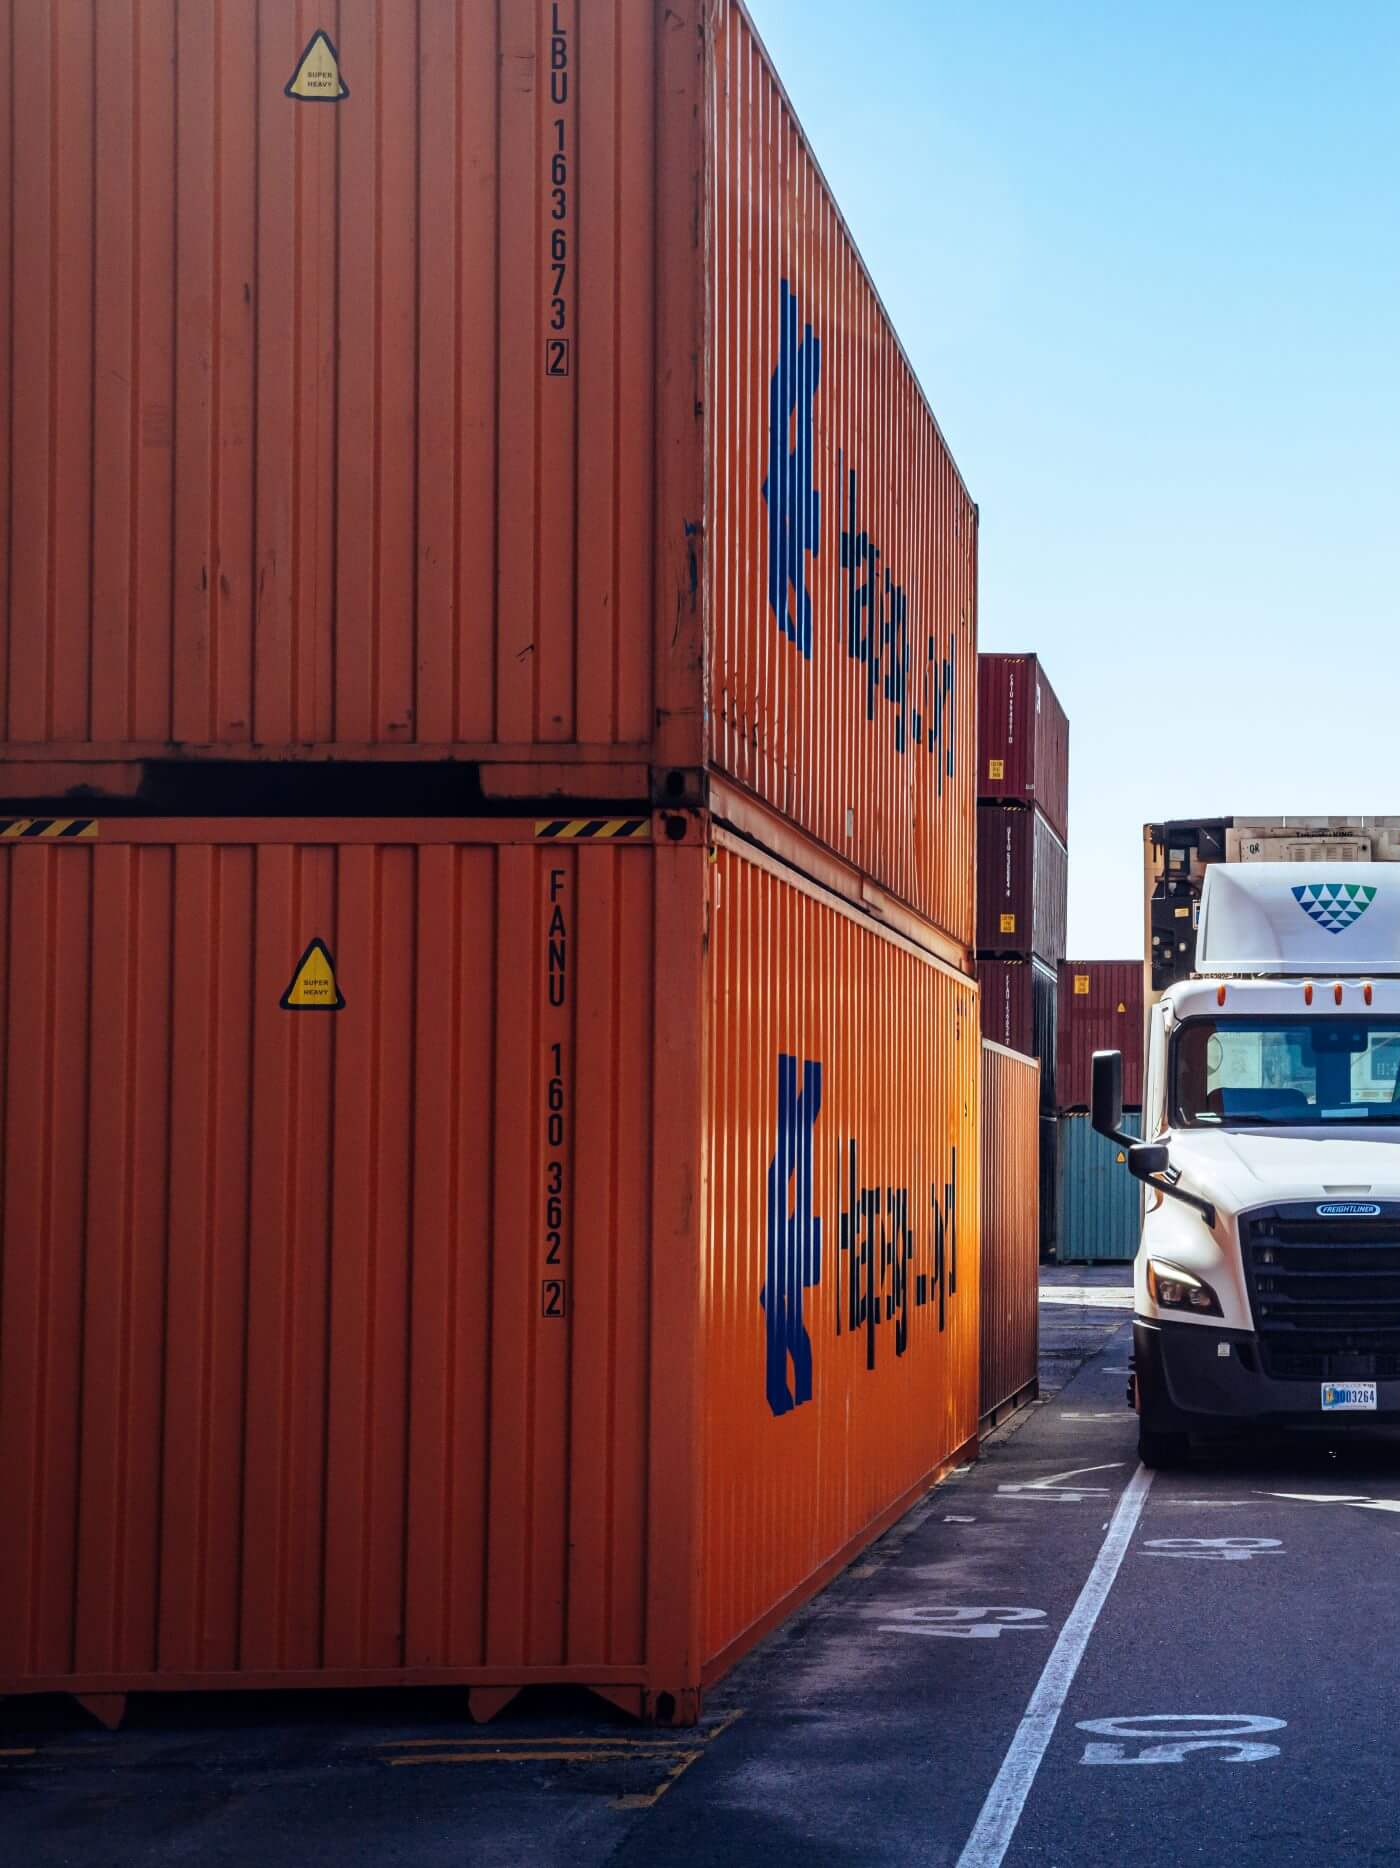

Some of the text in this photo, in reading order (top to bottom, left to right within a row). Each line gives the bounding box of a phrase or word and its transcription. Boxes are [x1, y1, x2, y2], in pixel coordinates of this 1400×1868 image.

[548, 340, 567, 375] 2
[547, 870, 567, 1007] FANU
[542, 1279, 564, 1317] 2
[1075, 1713, 1288, 1765] 50
